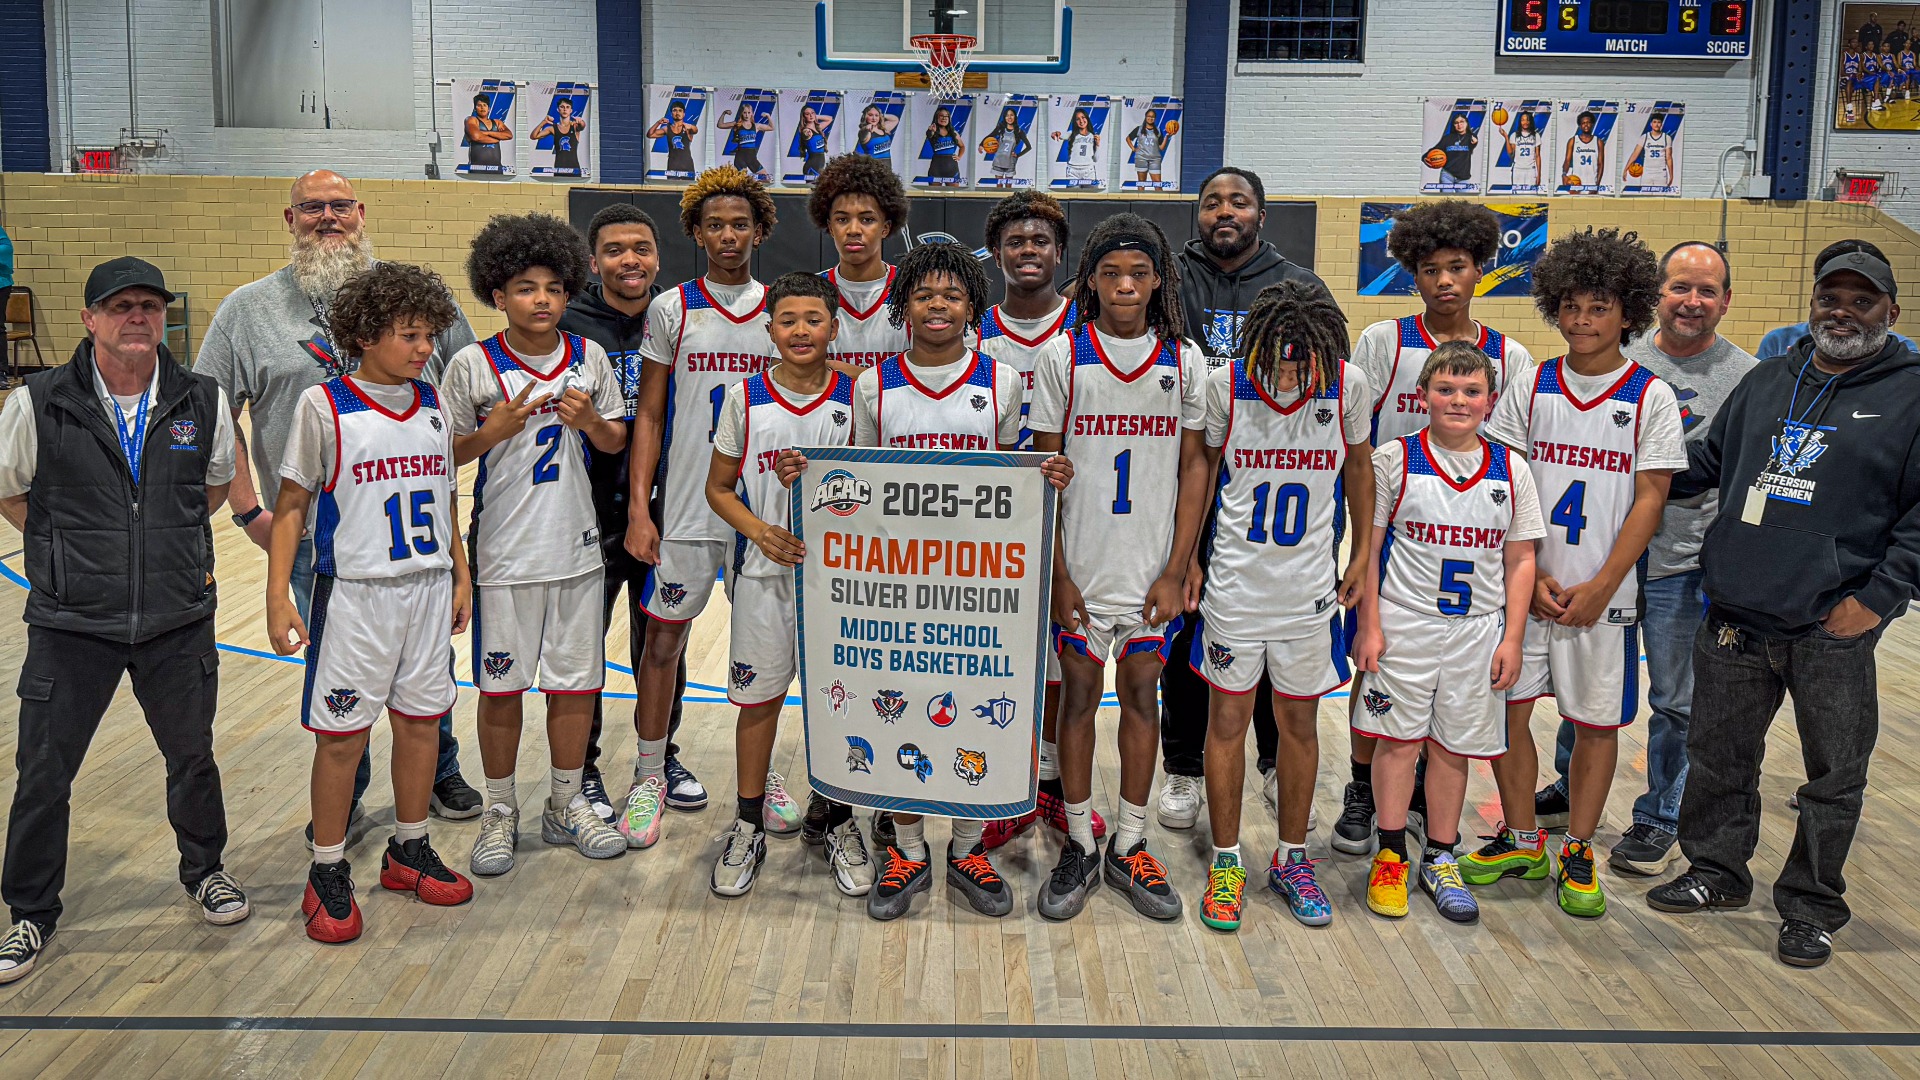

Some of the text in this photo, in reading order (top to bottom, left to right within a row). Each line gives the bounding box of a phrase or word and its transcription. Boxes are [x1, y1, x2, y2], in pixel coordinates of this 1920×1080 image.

[1525, 0, 1542, 30] 5
[1562, 8, 1574, 28] 5
[1683, 10, 1694, 31] 5
[1726, 4, 1741, 33] 3
[1507, 37, 1547, 50] SCORE
[1606, 39, 1647, 52] MATCH
[1707, 41, 1745, 53] SCORE
[984, 95, 990, 105] 2
[1055, 97, 1061, 107] 3
[1125, 98, 1134, 107] 44
[1560, 102, 1570, 112] 34
[1626, 103, 1636, 112] 35
[1004, 143, 1010, 152] 2
[1079, 144, 1087, 156] 3
[1520, 148, 1530, 156] 23
[85, 151, 111, 170] EXIT
[1580, 155, 1592, 165] 34
[1849, 178, 1877, 195] EXIT
[688, 352, 772, 373] STATESME
[1074, 415, 1178, 436] STATESMEN
[890, 433, 988, 450] STATESMEN
[533, 424, 564, 486] 2
[1234, 449, 1337, 470] STATESMEN
[1531, 441, 1633, 474] STATESMEN
[1112, 449, 1132, 514] 1
[811, 478, 871, 512] ACAC
[883, 482, 1012, 519] 2025-26
[1247, 481, 1310, 547] 10
[1550, 479, 1587, 545] 4
[384, 489, 440, 561] 15
[823, 531, 1026, 579] CHAMPIONS
[831, 577, 1019, 613] SILVER DIVISION
[1437, 558, 1474, 616] 5
[840, 616, 1002, 649] MIDDLE SCHOOL
[833, 643, 1014, 677] BOYS BASKETBALL
[1425, 846, 1441, 856] NIK
